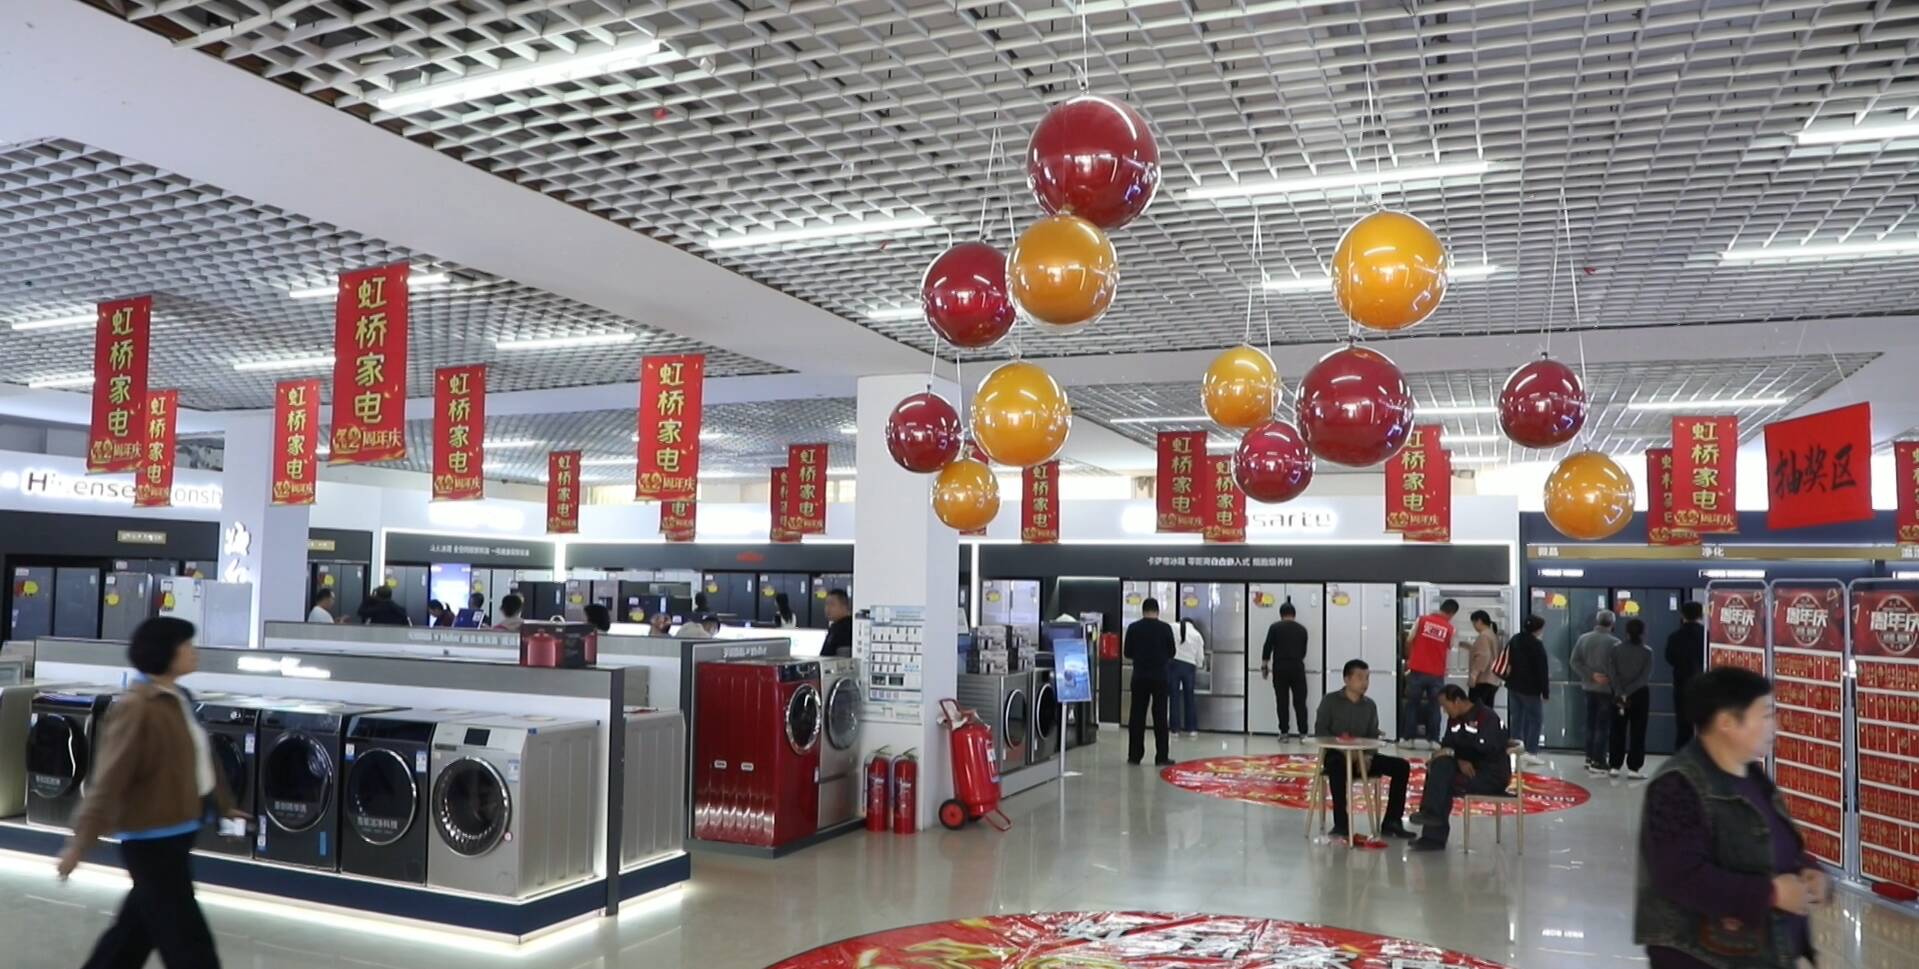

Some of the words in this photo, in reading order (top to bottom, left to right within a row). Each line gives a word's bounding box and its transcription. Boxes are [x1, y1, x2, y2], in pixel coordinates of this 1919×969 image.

[109, 306, 135, 437] 虹桥家电
[354, 276, 387, 424] 虹桥家电
[147, 396, 166, 484] 虹桥家电
[287, 386, 306, 480] 虹桥家电
[449, 373, 471, 474] 虹桥家电
[656, 362, 685, 472] 虹桥家电
[28, 471, 135, 498] Hiense
[557, 455, 571, 518] 虹桥家电
[800, 449, 816, 517] 虹桥家电
[1032, 465, 1048, 528] 虹桥家电
[1171, 437, 1192, 513] 虹桥家电
[1215, 461, 1234, 526] 虹桥家电
[1691, 422, 1719, 510] 虹桥家电
[1774, 443, 1857, 499] 抽奖区
[1702, 546, 1725, 558] 净化
[1719, 607, 1756, 627] 周年庆
[1785, 607, 1829, 628] 周年庆
[1870, 610, 1919, 633] 周年庆
